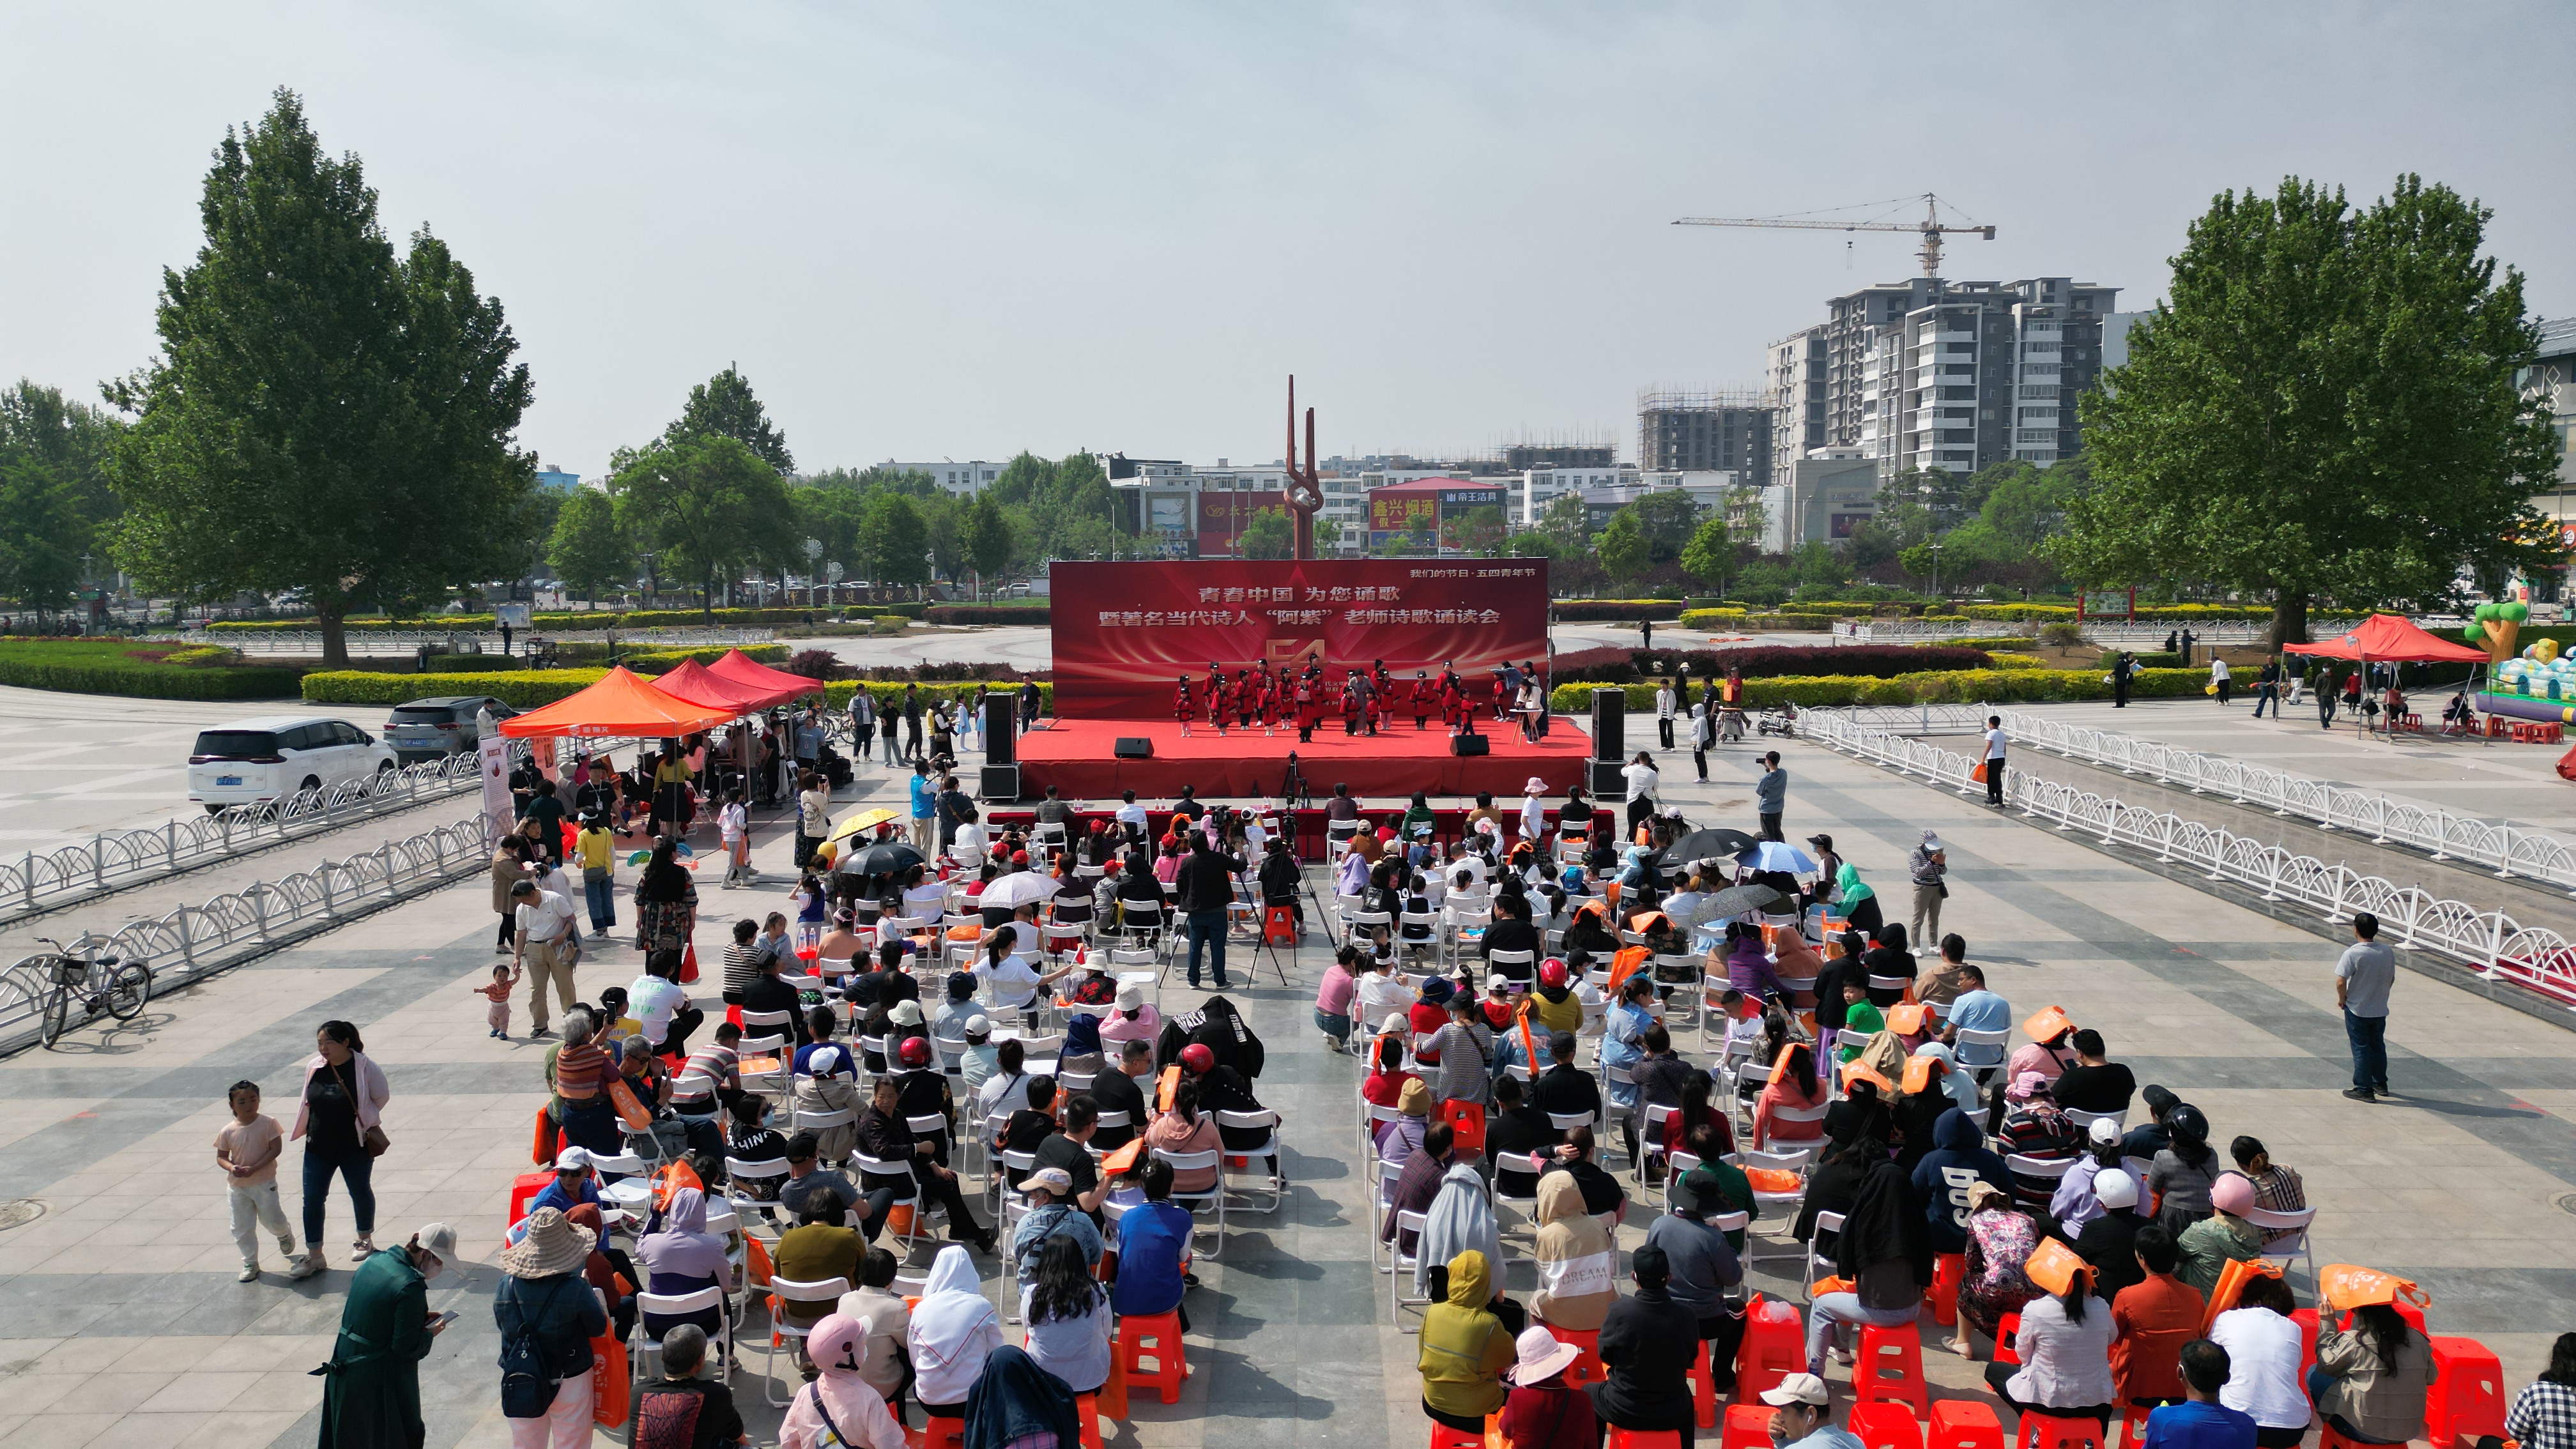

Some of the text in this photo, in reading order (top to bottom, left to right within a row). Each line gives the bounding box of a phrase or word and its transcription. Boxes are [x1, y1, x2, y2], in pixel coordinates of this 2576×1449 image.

[1458, 492, 1497, 502] 帝王洁具
[1374, 498, 1434, 517] 鑫兴烟酒
[1198, 586, 1401, 602] 青春中国 为您诵歌
[1098, 610, 1255, 627] 暨著名当代诗人
[1344, 609, 1501, 625] 老师诗歌诵读会
[1562, 1266, 1607, 1285] DREAM
